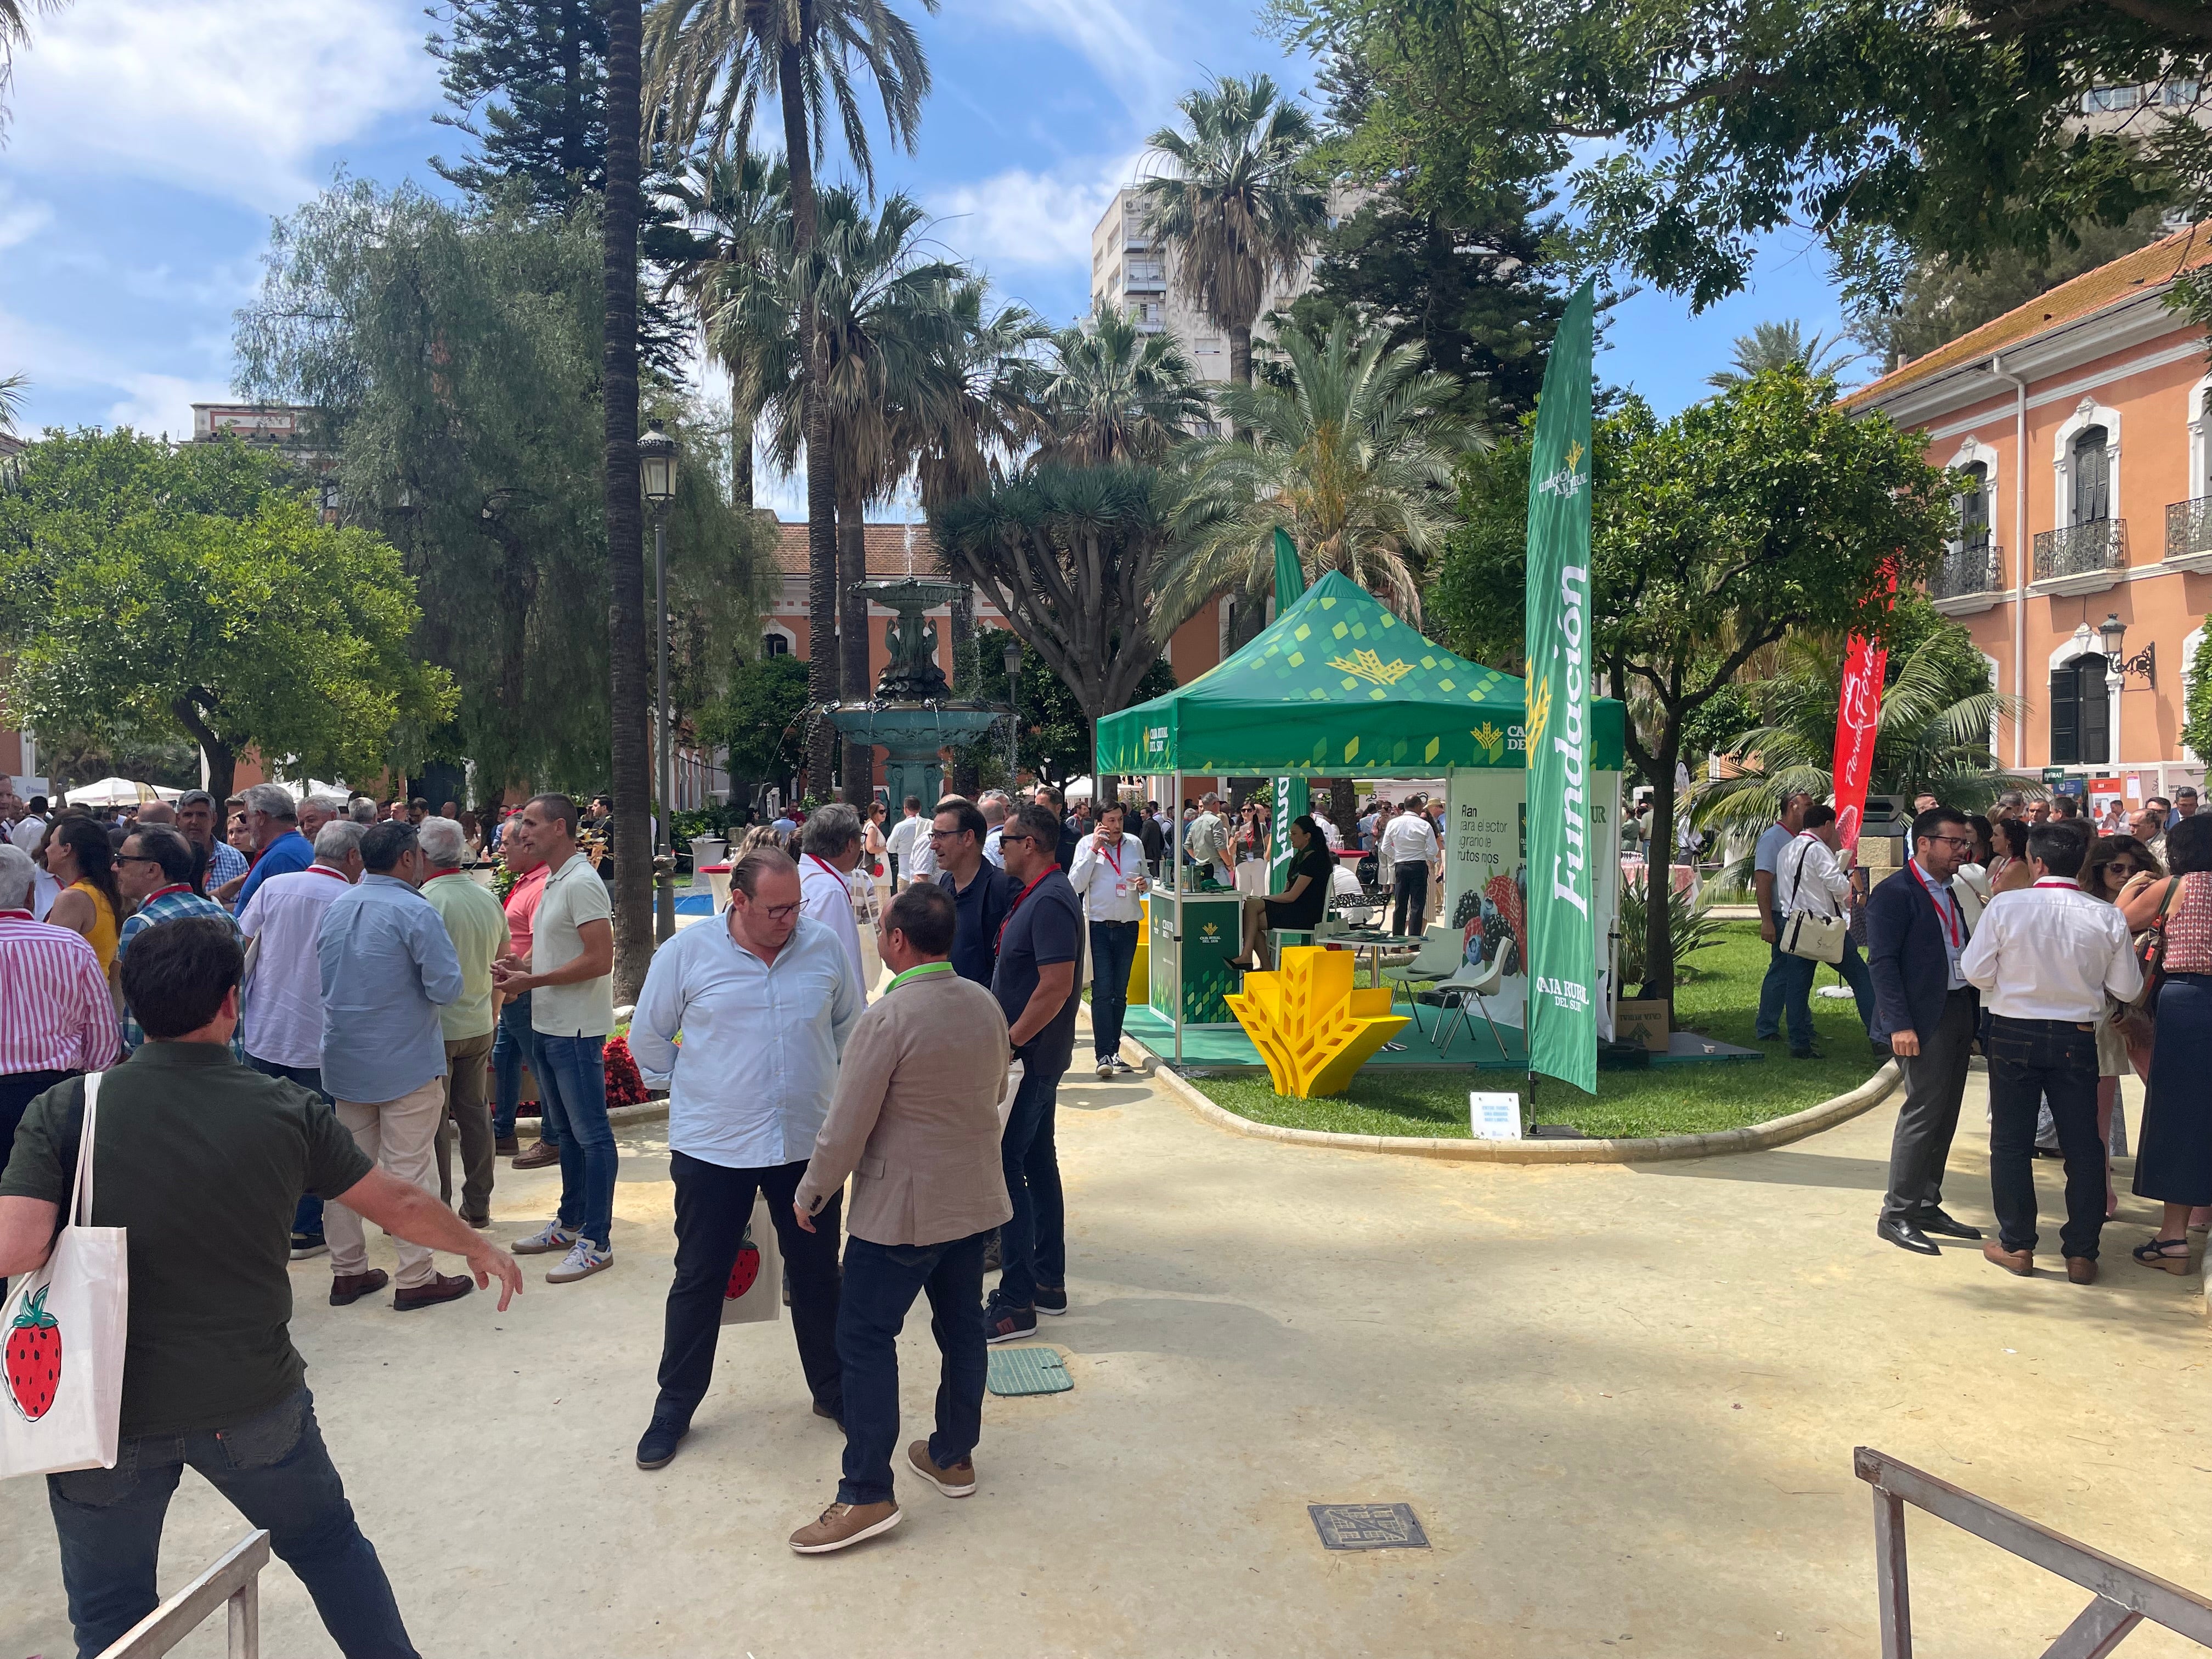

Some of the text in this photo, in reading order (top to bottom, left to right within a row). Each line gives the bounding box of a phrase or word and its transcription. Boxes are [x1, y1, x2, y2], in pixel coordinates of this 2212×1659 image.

[1508, 726, 1526, 737] CA
[1508, 739, 1526, 750] DE
[1554, 564, 1587, 922] Fundación
[1846, 716, 1864, 787] Florida
[1590, 806, 1606, 823] UR
[1485, 820, 1507, 833] sector
[1537, 977, 1589, 1005] CAJA RURAL
[1555, 996, 1582, 1012] DEL SUR
